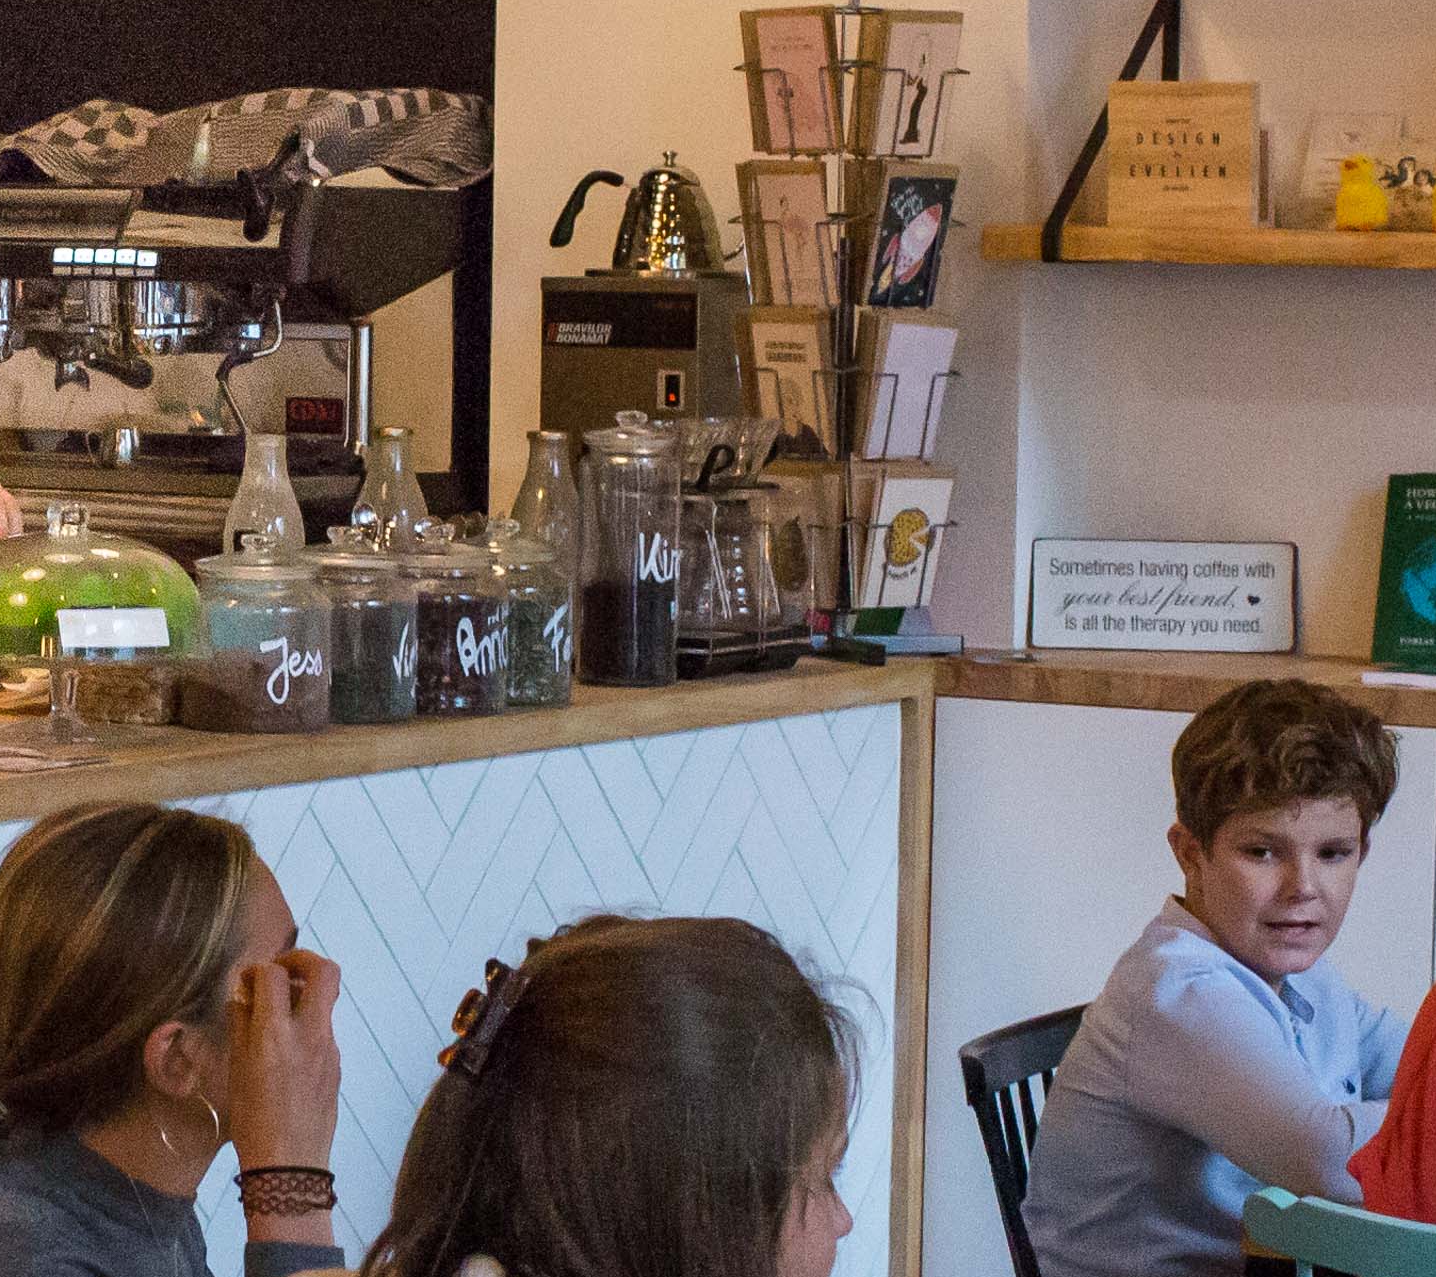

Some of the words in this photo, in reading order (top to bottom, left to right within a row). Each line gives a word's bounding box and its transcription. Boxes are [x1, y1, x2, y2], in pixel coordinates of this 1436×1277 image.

[1136, 131, 1221, 146] DESIGN
[1405, 488, 1436, 498] HOW
[1404, 500, 1414, 510] A
[1050, 558, 1135, 576] Sometimes
[1140, 559, 1188, 581] having
[1193, 561, 1239, 578] coffee
[1244, 560, 1276, 579] with
[1056, 592, 1113, 615] your
[1118, 580, 1165, 608] best
[1082, 614, 1098, 632] all
[1103, 615, 1125, 632] the
[1131, 614, 1185, 636] therapy
[1191, 618, 1219, 637] you
